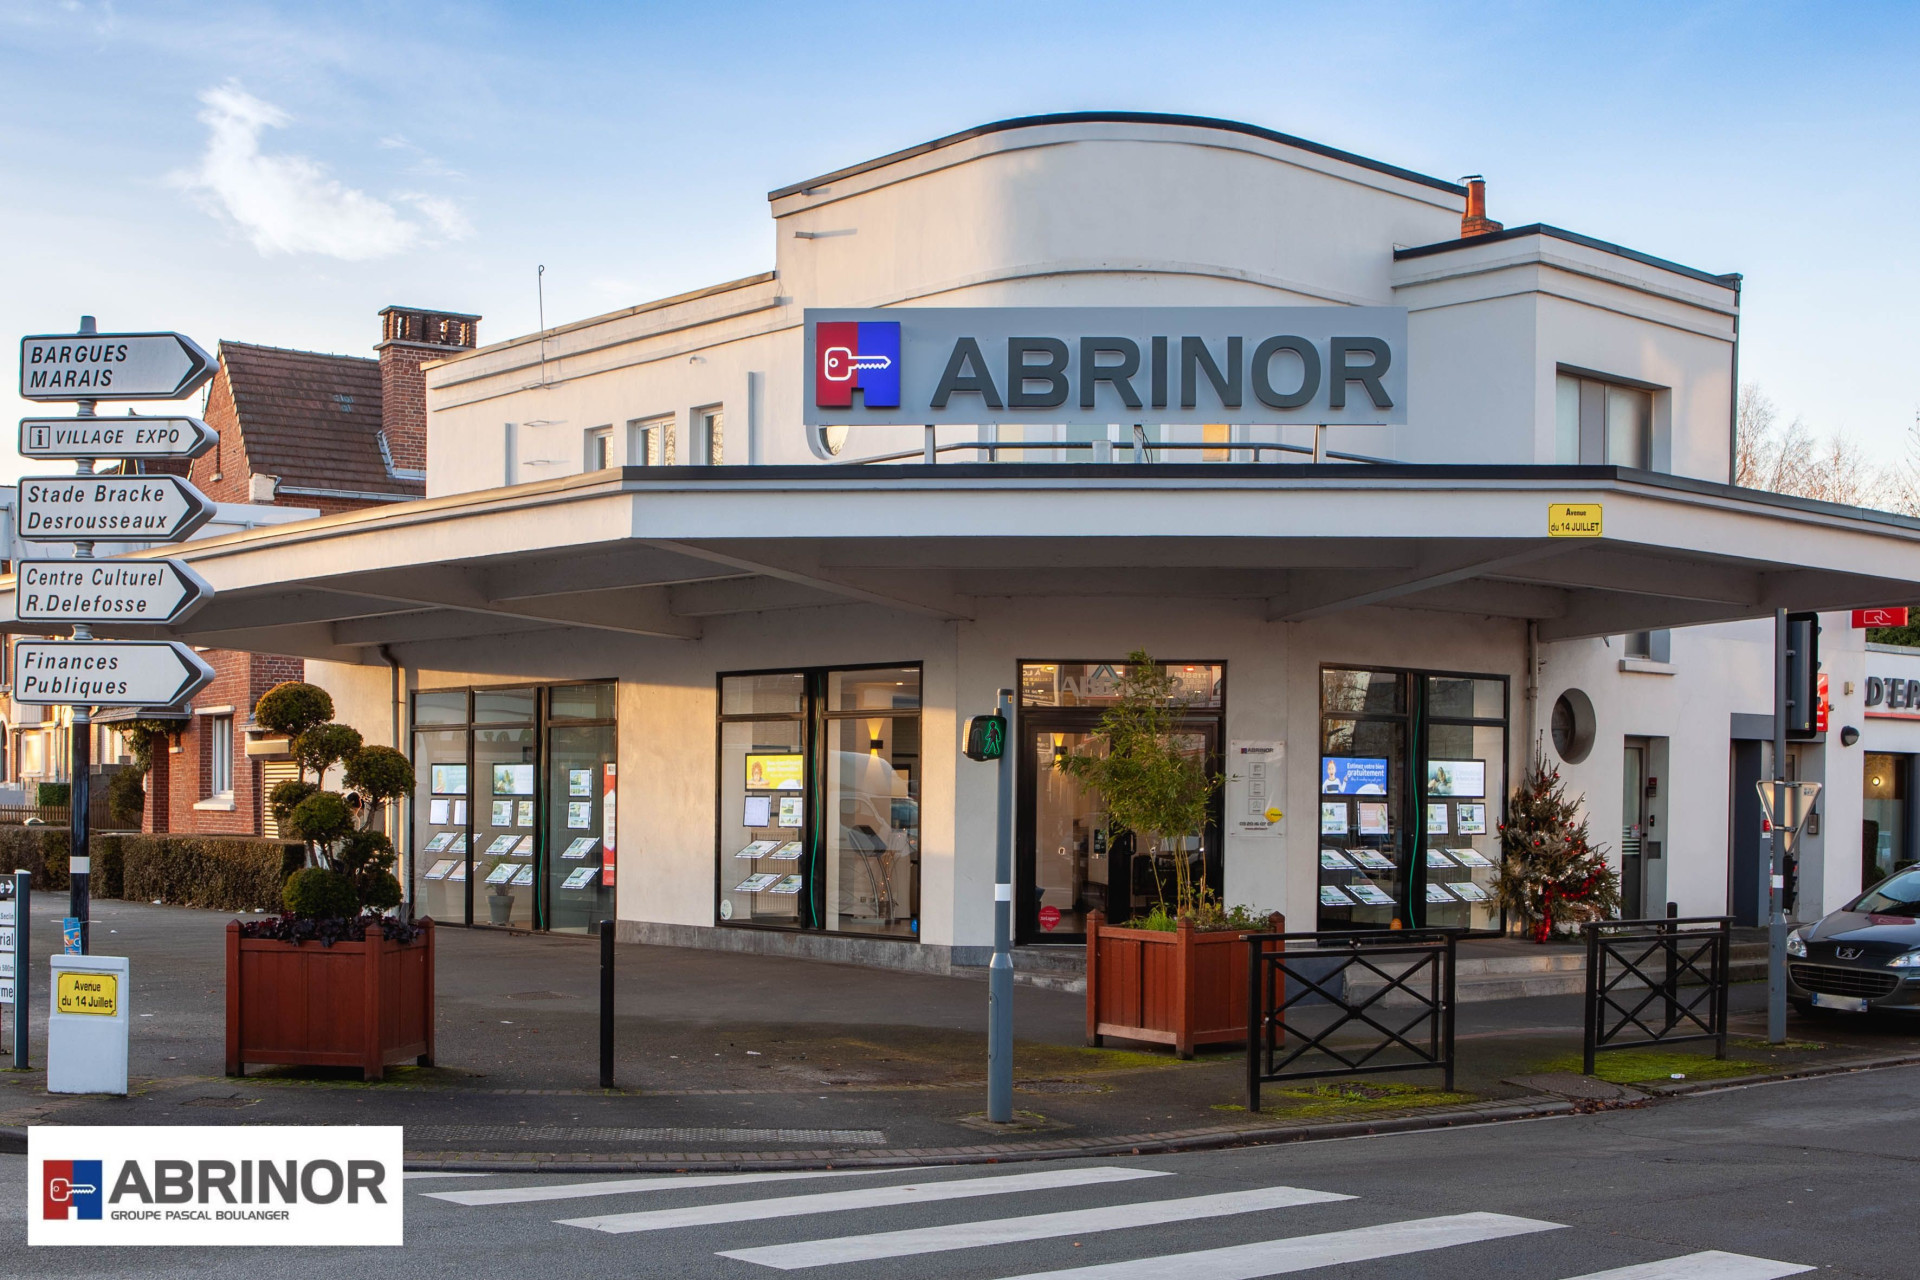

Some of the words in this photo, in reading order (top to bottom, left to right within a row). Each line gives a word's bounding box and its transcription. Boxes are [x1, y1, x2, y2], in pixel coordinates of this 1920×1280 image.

[30, 345, 128, 364] BARGUES
[30, 369, 113, 388] MARAIS
[929, 335, 1394, 410] ABRINOR
[56, 429, 125, 445] VILLAGE
[135, 429, 180, 444] EXPO
[27, 486, 85, 503] Stade
[94, 484, 164, 503] Bracke
[27, 512, 168, 530] Desrousseaux
[1566, 508, 1587, 516] Avenue
[1551, 523, 1560, 532] du
[1561, 522, 1570, 532] 14
[1572, 522, 1600, 532] JUILLET
[26, 568, 84, 586] Centre
[92, 568, 164, 586] Culturel
[25, 594, 147, 612] R.Delefosse
[25, 651, 119, 670] Finances
[24, 676, 128, 697] Publiques
[74, 980, 101, 992] Avenue
[61, 995, 72, 1006] du
[75, 995, 87, 1007] 14
[88, 996, 113, 1008] Juillet
